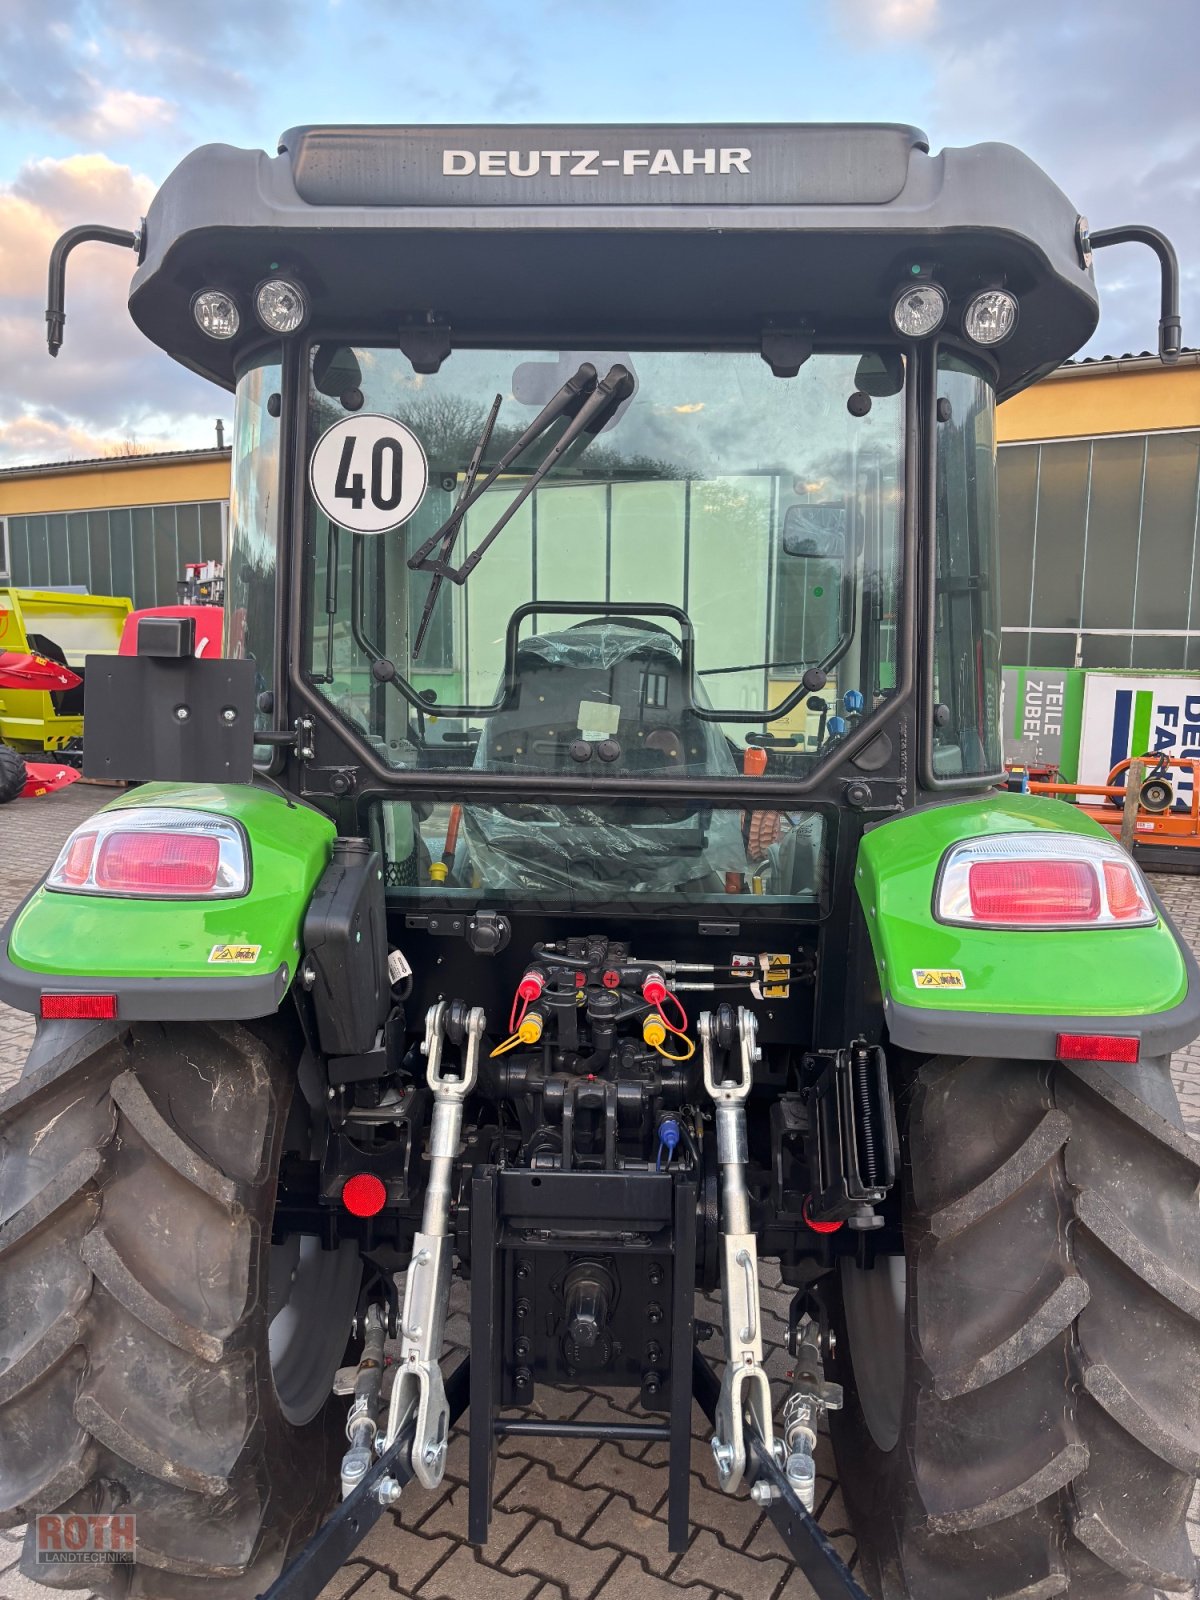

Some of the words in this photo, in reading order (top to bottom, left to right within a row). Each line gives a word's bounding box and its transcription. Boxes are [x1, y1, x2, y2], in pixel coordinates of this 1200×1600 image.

[442, 147, 752, 177] DEUTZ-FAHR
[334, 436, 403, 511] 40
[1023, 680, 1044, 766] ZUBEH
[1043, 681, 1065, 736] TEILE
